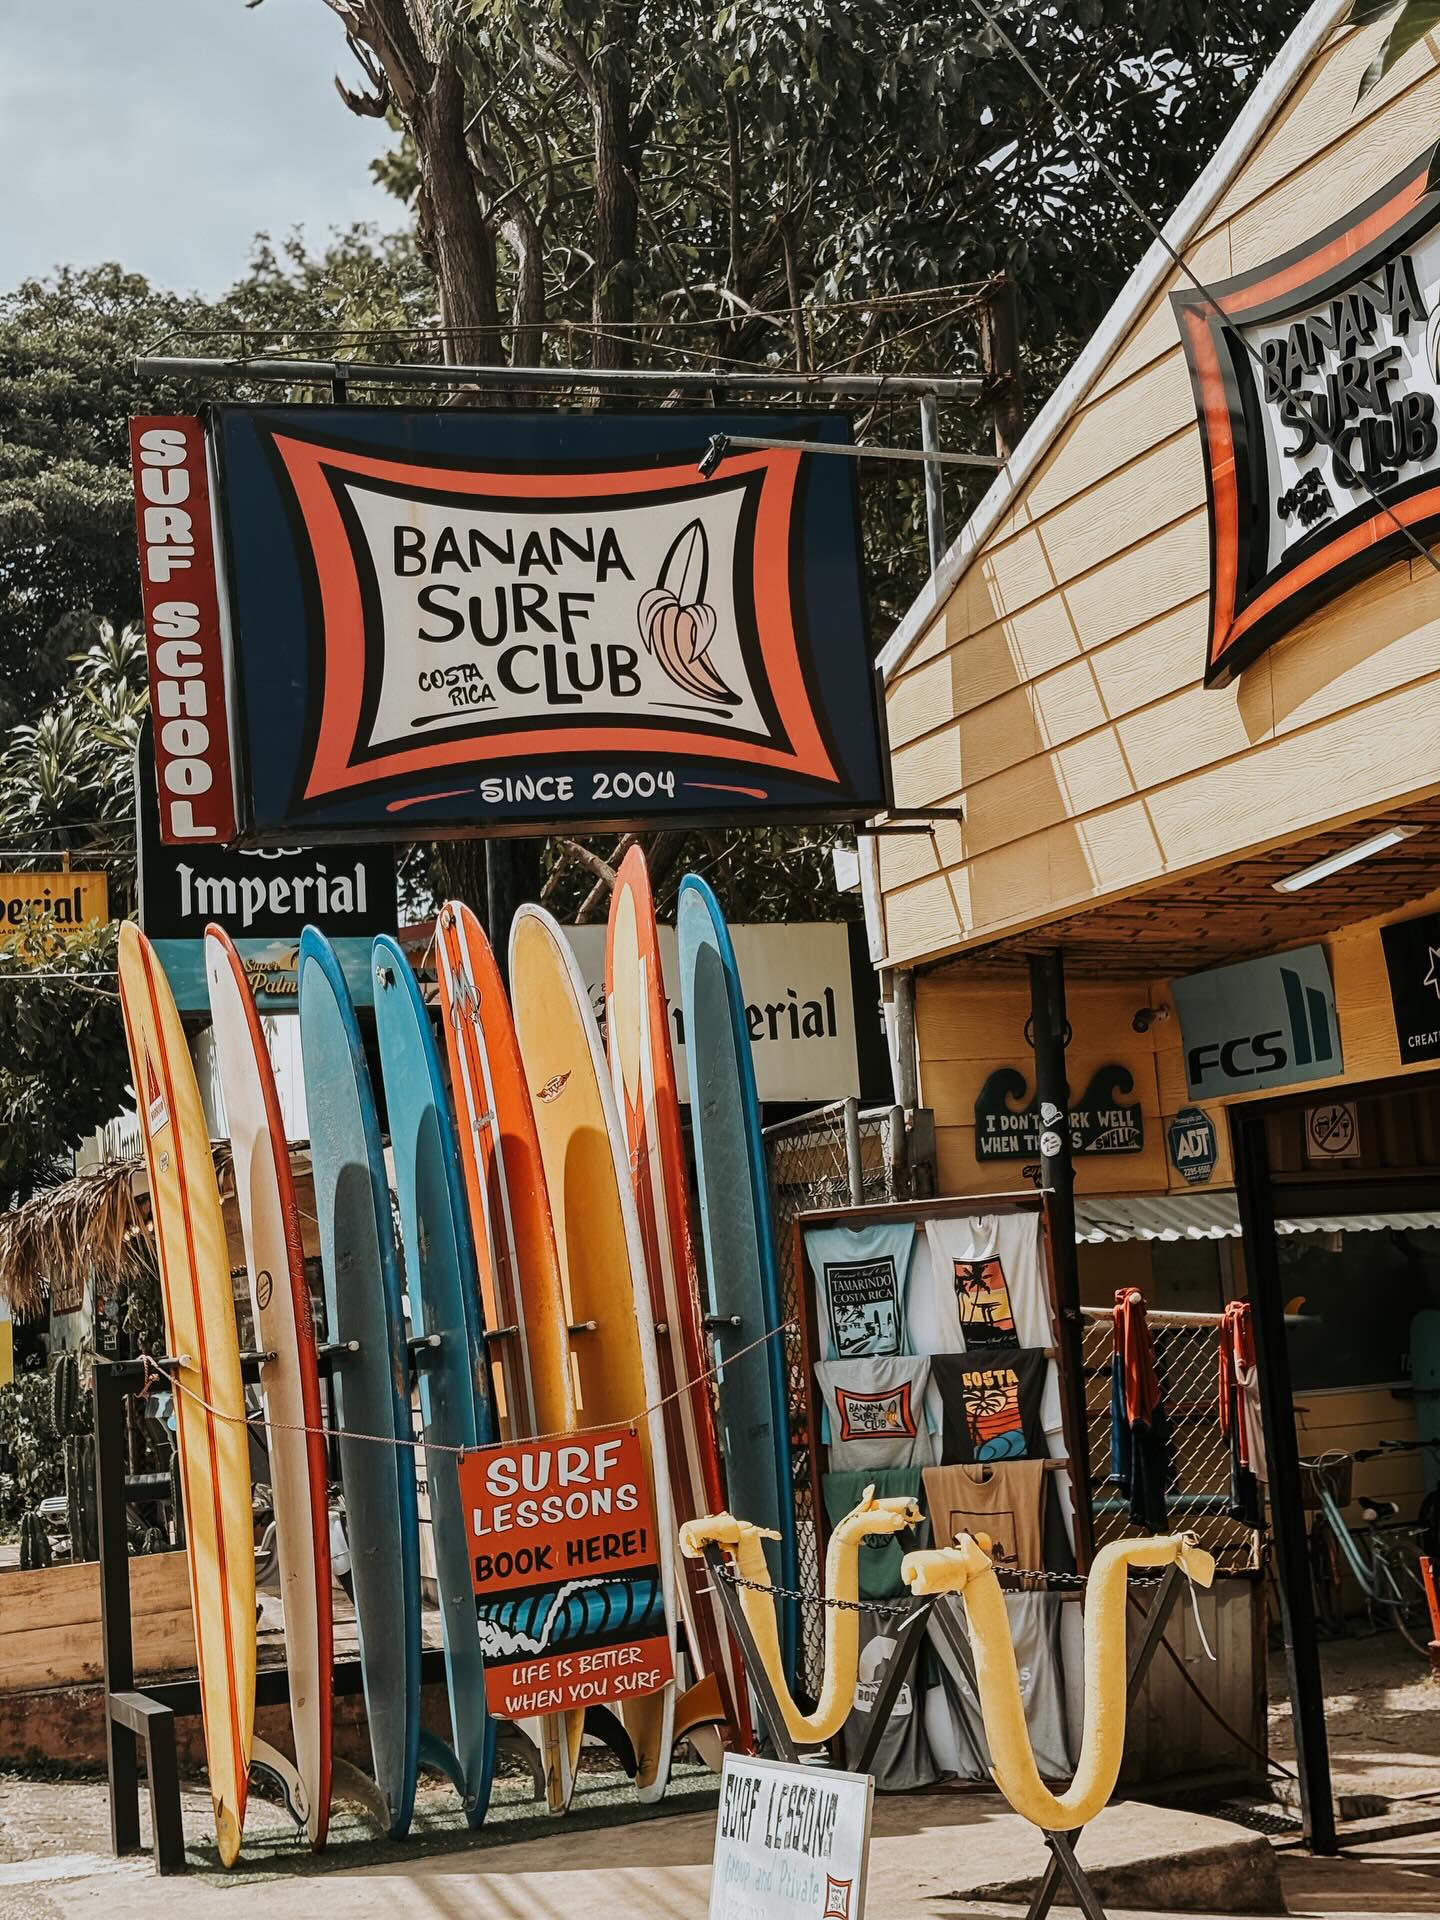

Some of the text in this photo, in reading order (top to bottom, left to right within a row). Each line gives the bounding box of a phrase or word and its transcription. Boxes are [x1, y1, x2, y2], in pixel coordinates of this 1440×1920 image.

[1260, 254, 1429, 405] BANANA
[1280, 345, 1402, 459] SURF
[1332, 391, 1439, 493] CLUB
[393, 525, 636, 583] BANANA
[139, 428, 217, 839] SURF SCHOOL
[417, 582, 596, 647] SURF
[418, 663, 484, 692] COSTA
[497, 643, 642, 705] CLUB
[448, 683, 497, 707] RICA
[480, 771, 676, 803] SINCE 2004
[175, 862, 367, 928] Imperial
[245, 959, 280, 973] Super
[1188, 1030, 1288, 1086] FCS
[1408, 1031, 1440, 1048] CREAT
[986, 1115, 995, 1132] I
[1001, 1113, 1039, 1130] DON'T
[1098, 1110, 1134, 1128] WELL
[981, 1135, 1019, 1153] WHEN
[1178, 1127, 1209, 1160] ADT
[831, 1274, 891, 1292] TAMARINDO
[833, 1289, 893, 1304] COSTA RICA
[849, 1402, 885, 1412] BANANA
[852, 1411, 880, 1421] SURF
[864, 1420, 887, 1430] CLUB
[486, 1439, 623, 1497] SURF
[473, 1484, 638, 1537] LESSONS
[475, 1528, 647, 1582] BOOK HERE!
[512, 1647, 643, 1686] LIFE IS BETTER
[505, 1670, 662, 1713] WHEN YOU SURF
[721, 1773, 762, 1843] SURF
